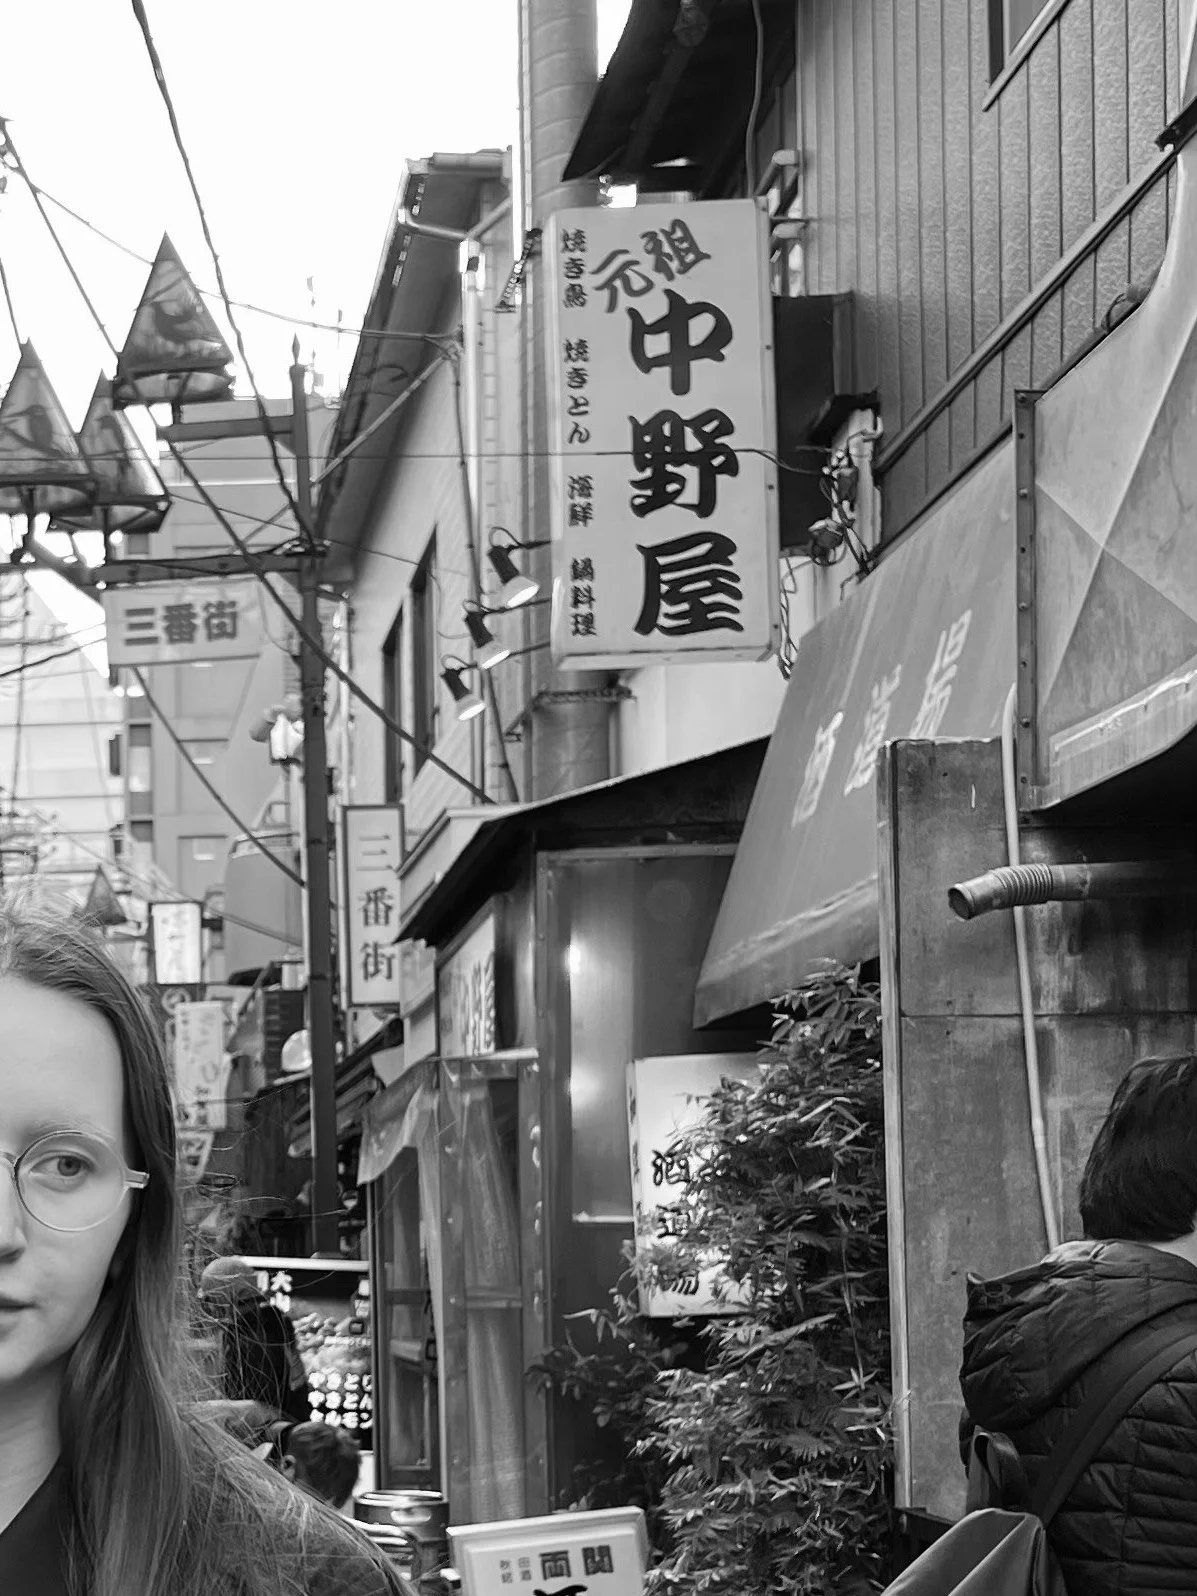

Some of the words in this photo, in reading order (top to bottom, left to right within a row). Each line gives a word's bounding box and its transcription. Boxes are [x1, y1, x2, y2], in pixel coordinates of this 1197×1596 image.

[590, 218, 711, 313] 元祖
[627, 288, 744, 636] 中野屋
[124, 600, 238, 643] 三番街
[355, 833, 396, 983] 三番街
